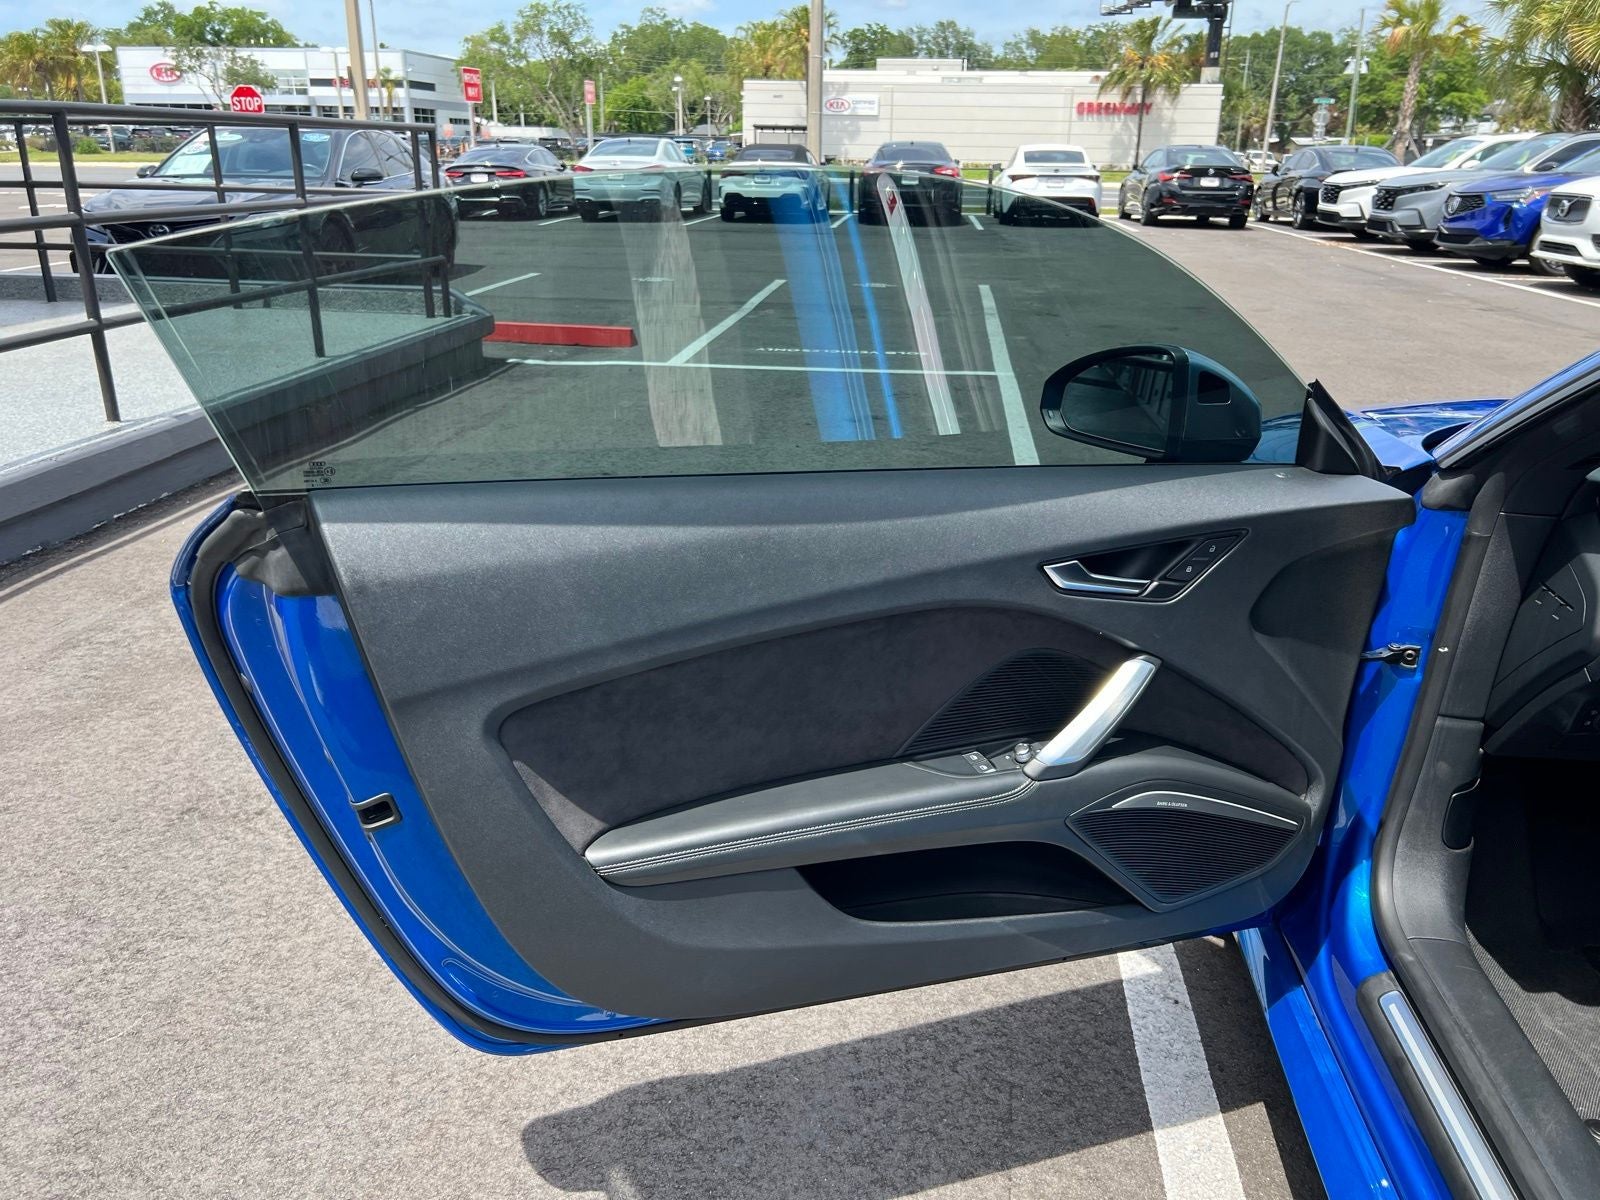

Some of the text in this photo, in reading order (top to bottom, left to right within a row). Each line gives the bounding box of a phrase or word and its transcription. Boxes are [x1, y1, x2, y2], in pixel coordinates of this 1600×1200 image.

[467, 87, 478, 98] WAY
[233, 96, 262, 111] STOP
[828, 101, 846, 110] KIA
